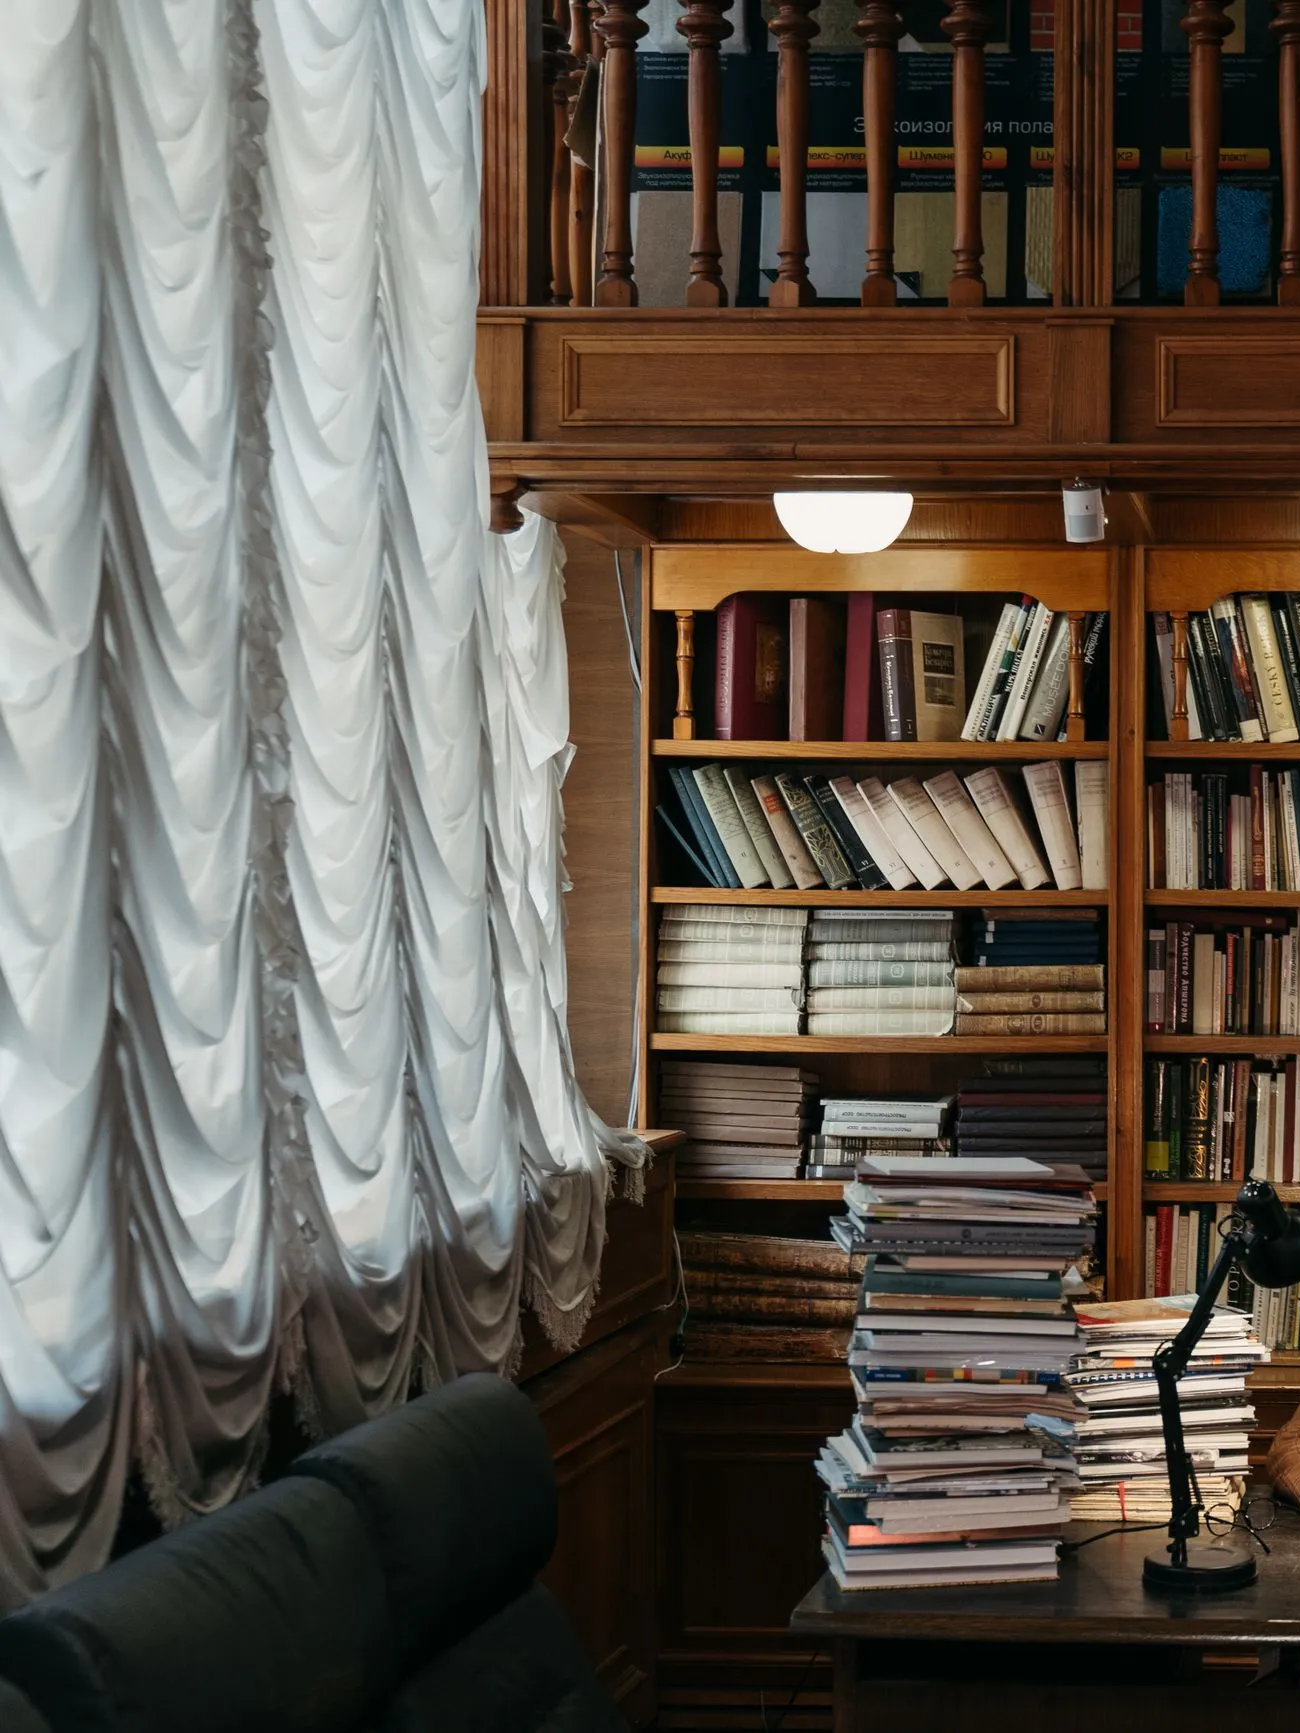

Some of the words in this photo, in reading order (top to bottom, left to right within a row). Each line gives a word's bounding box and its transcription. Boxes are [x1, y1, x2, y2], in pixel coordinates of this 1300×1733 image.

[1009, 121, 1054, 134] пола
[1004, 672, 1015, 692] МАРК
[1020, 660, 1037, 700] Венгерская
[976, 694, 997, 737] МАЛЕВИЧ
